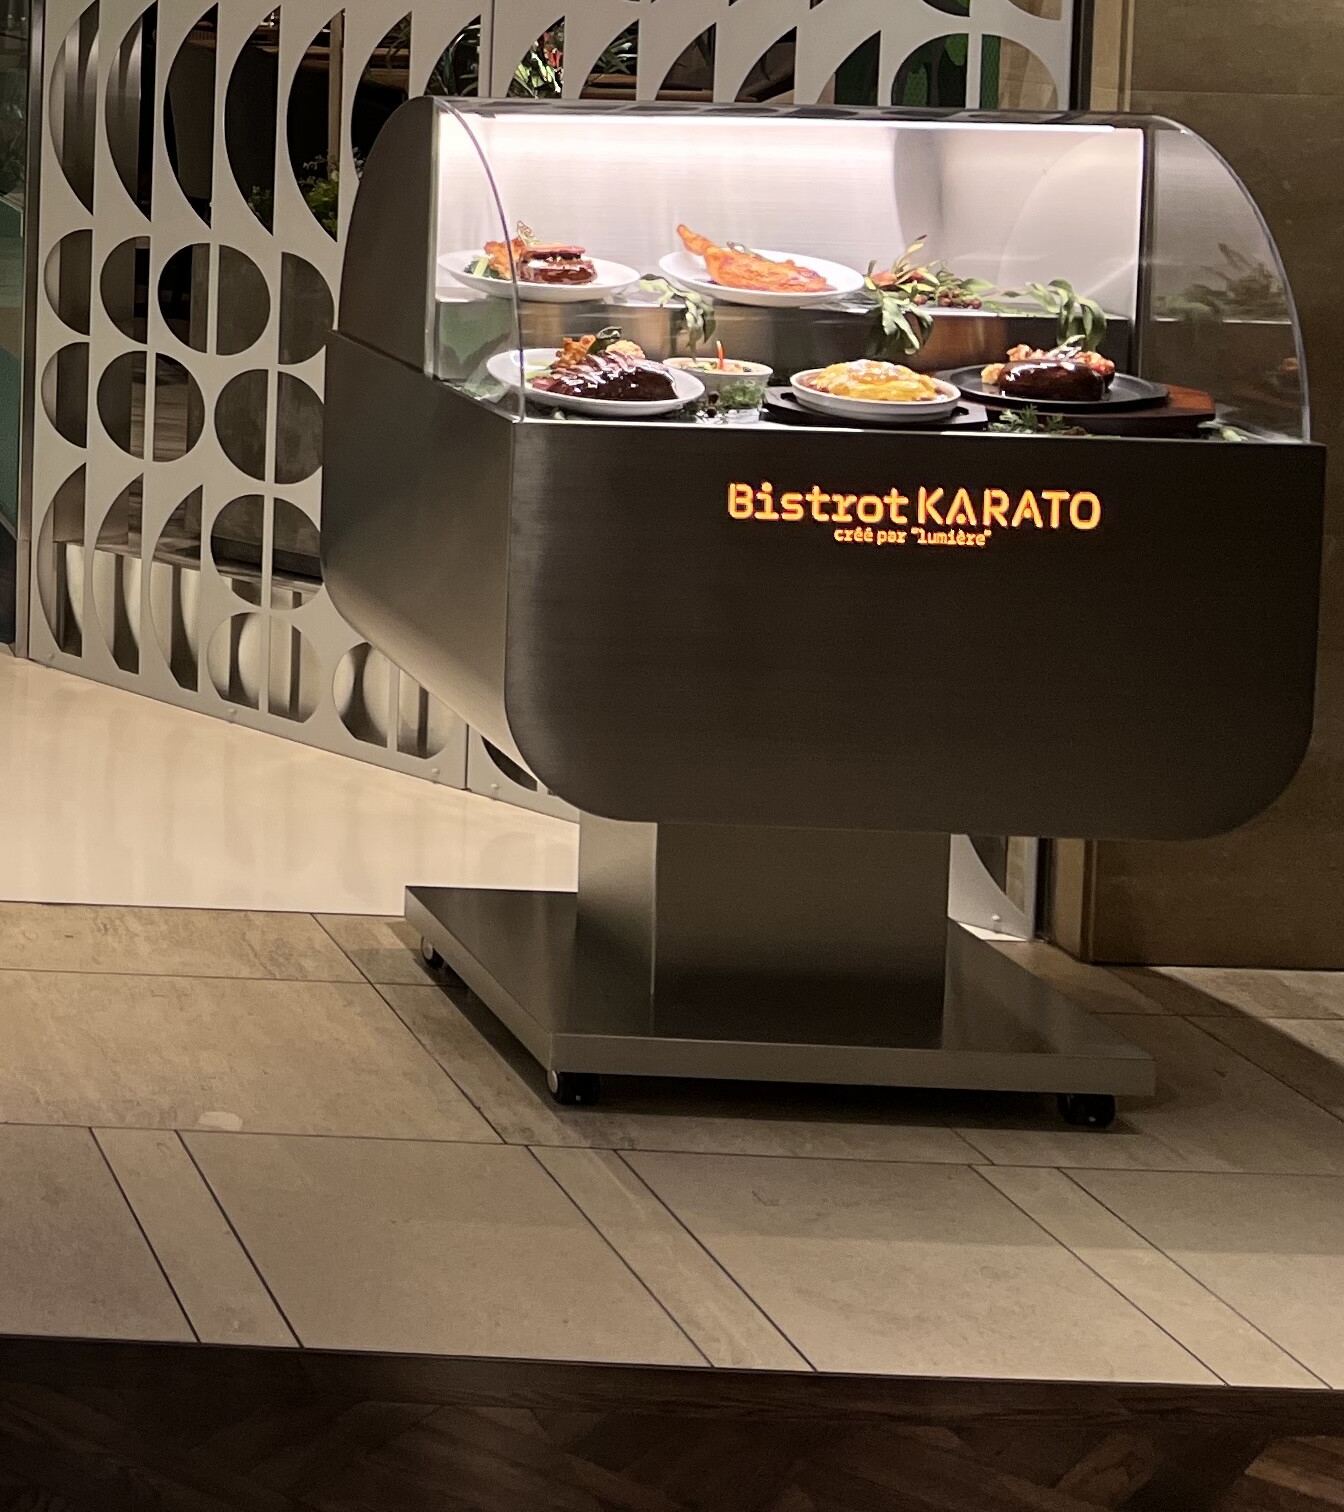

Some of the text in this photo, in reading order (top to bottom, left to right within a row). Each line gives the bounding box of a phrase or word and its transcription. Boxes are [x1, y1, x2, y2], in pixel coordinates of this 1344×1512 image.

[726, 481, 1102, 531] Bistrot KARATO
[833, 526, 874, 544] créé
[876, 529, 907, 546] par
